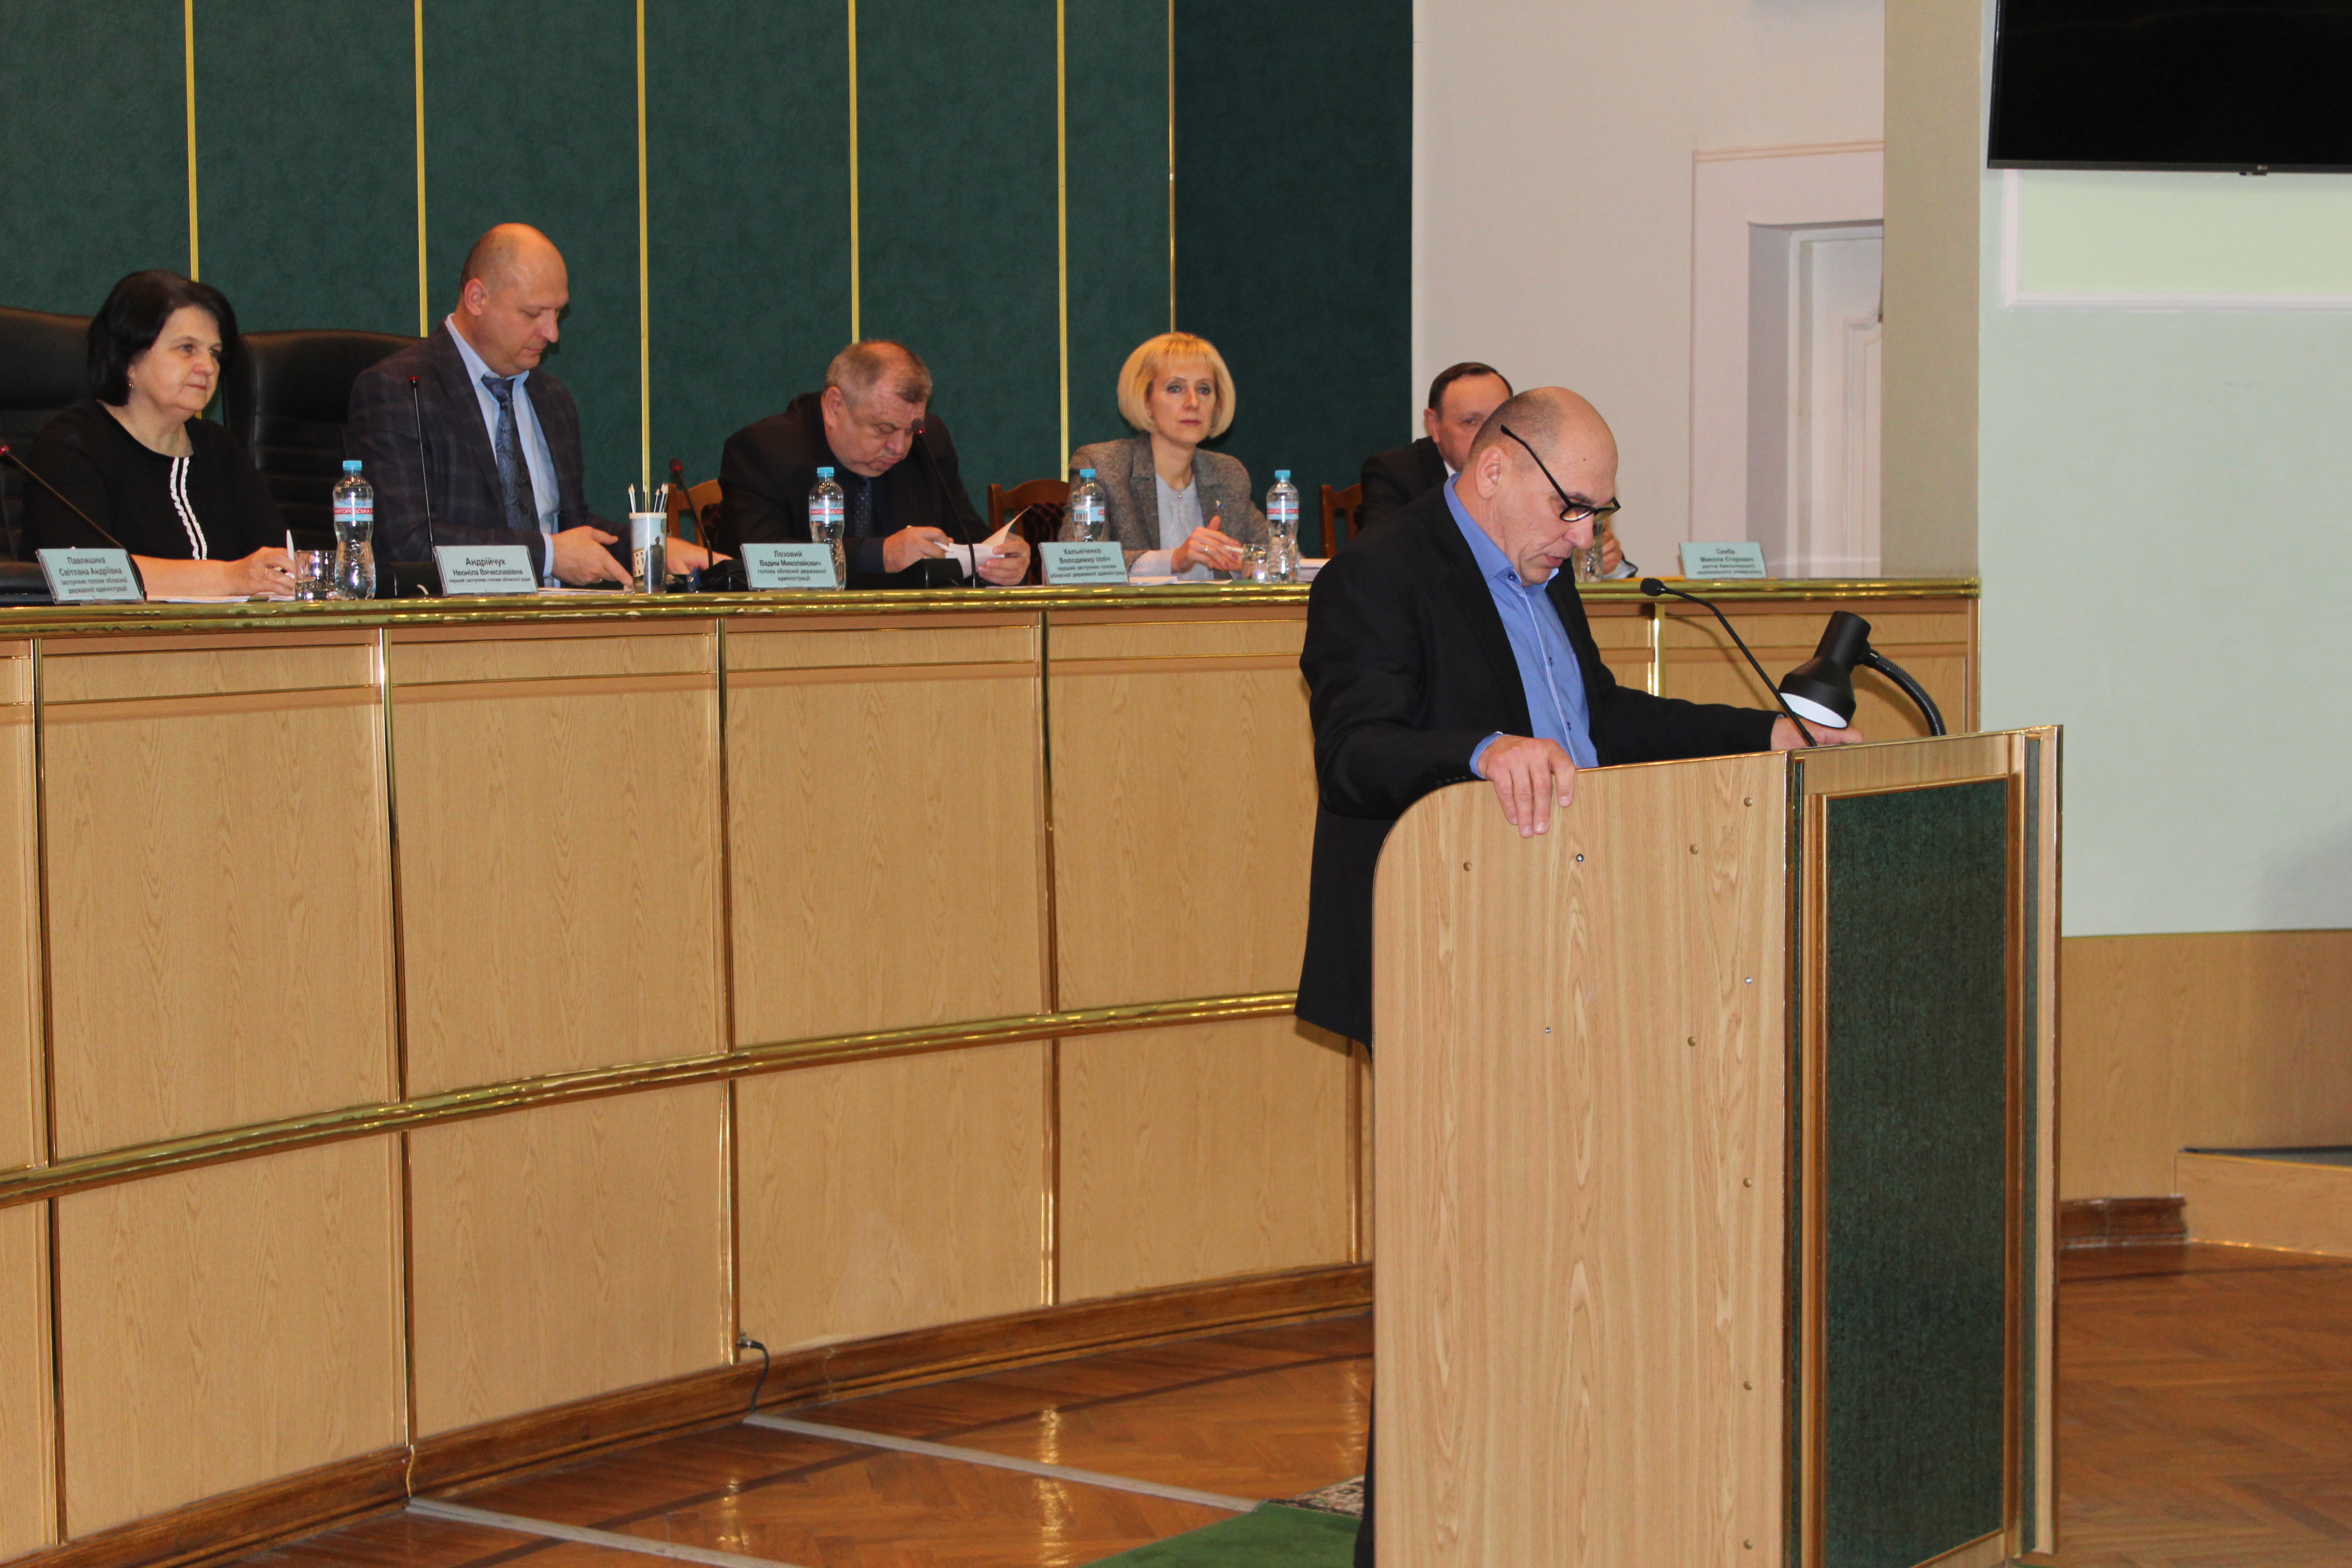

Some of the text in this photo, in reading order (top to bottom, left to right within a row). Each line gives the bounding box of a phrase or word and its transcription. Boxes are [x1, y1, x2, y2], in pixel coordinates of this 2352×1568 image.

[466, 557, 506, 567] Андрійчук
[59, 567, 122, 576] Світлана Андріївна
